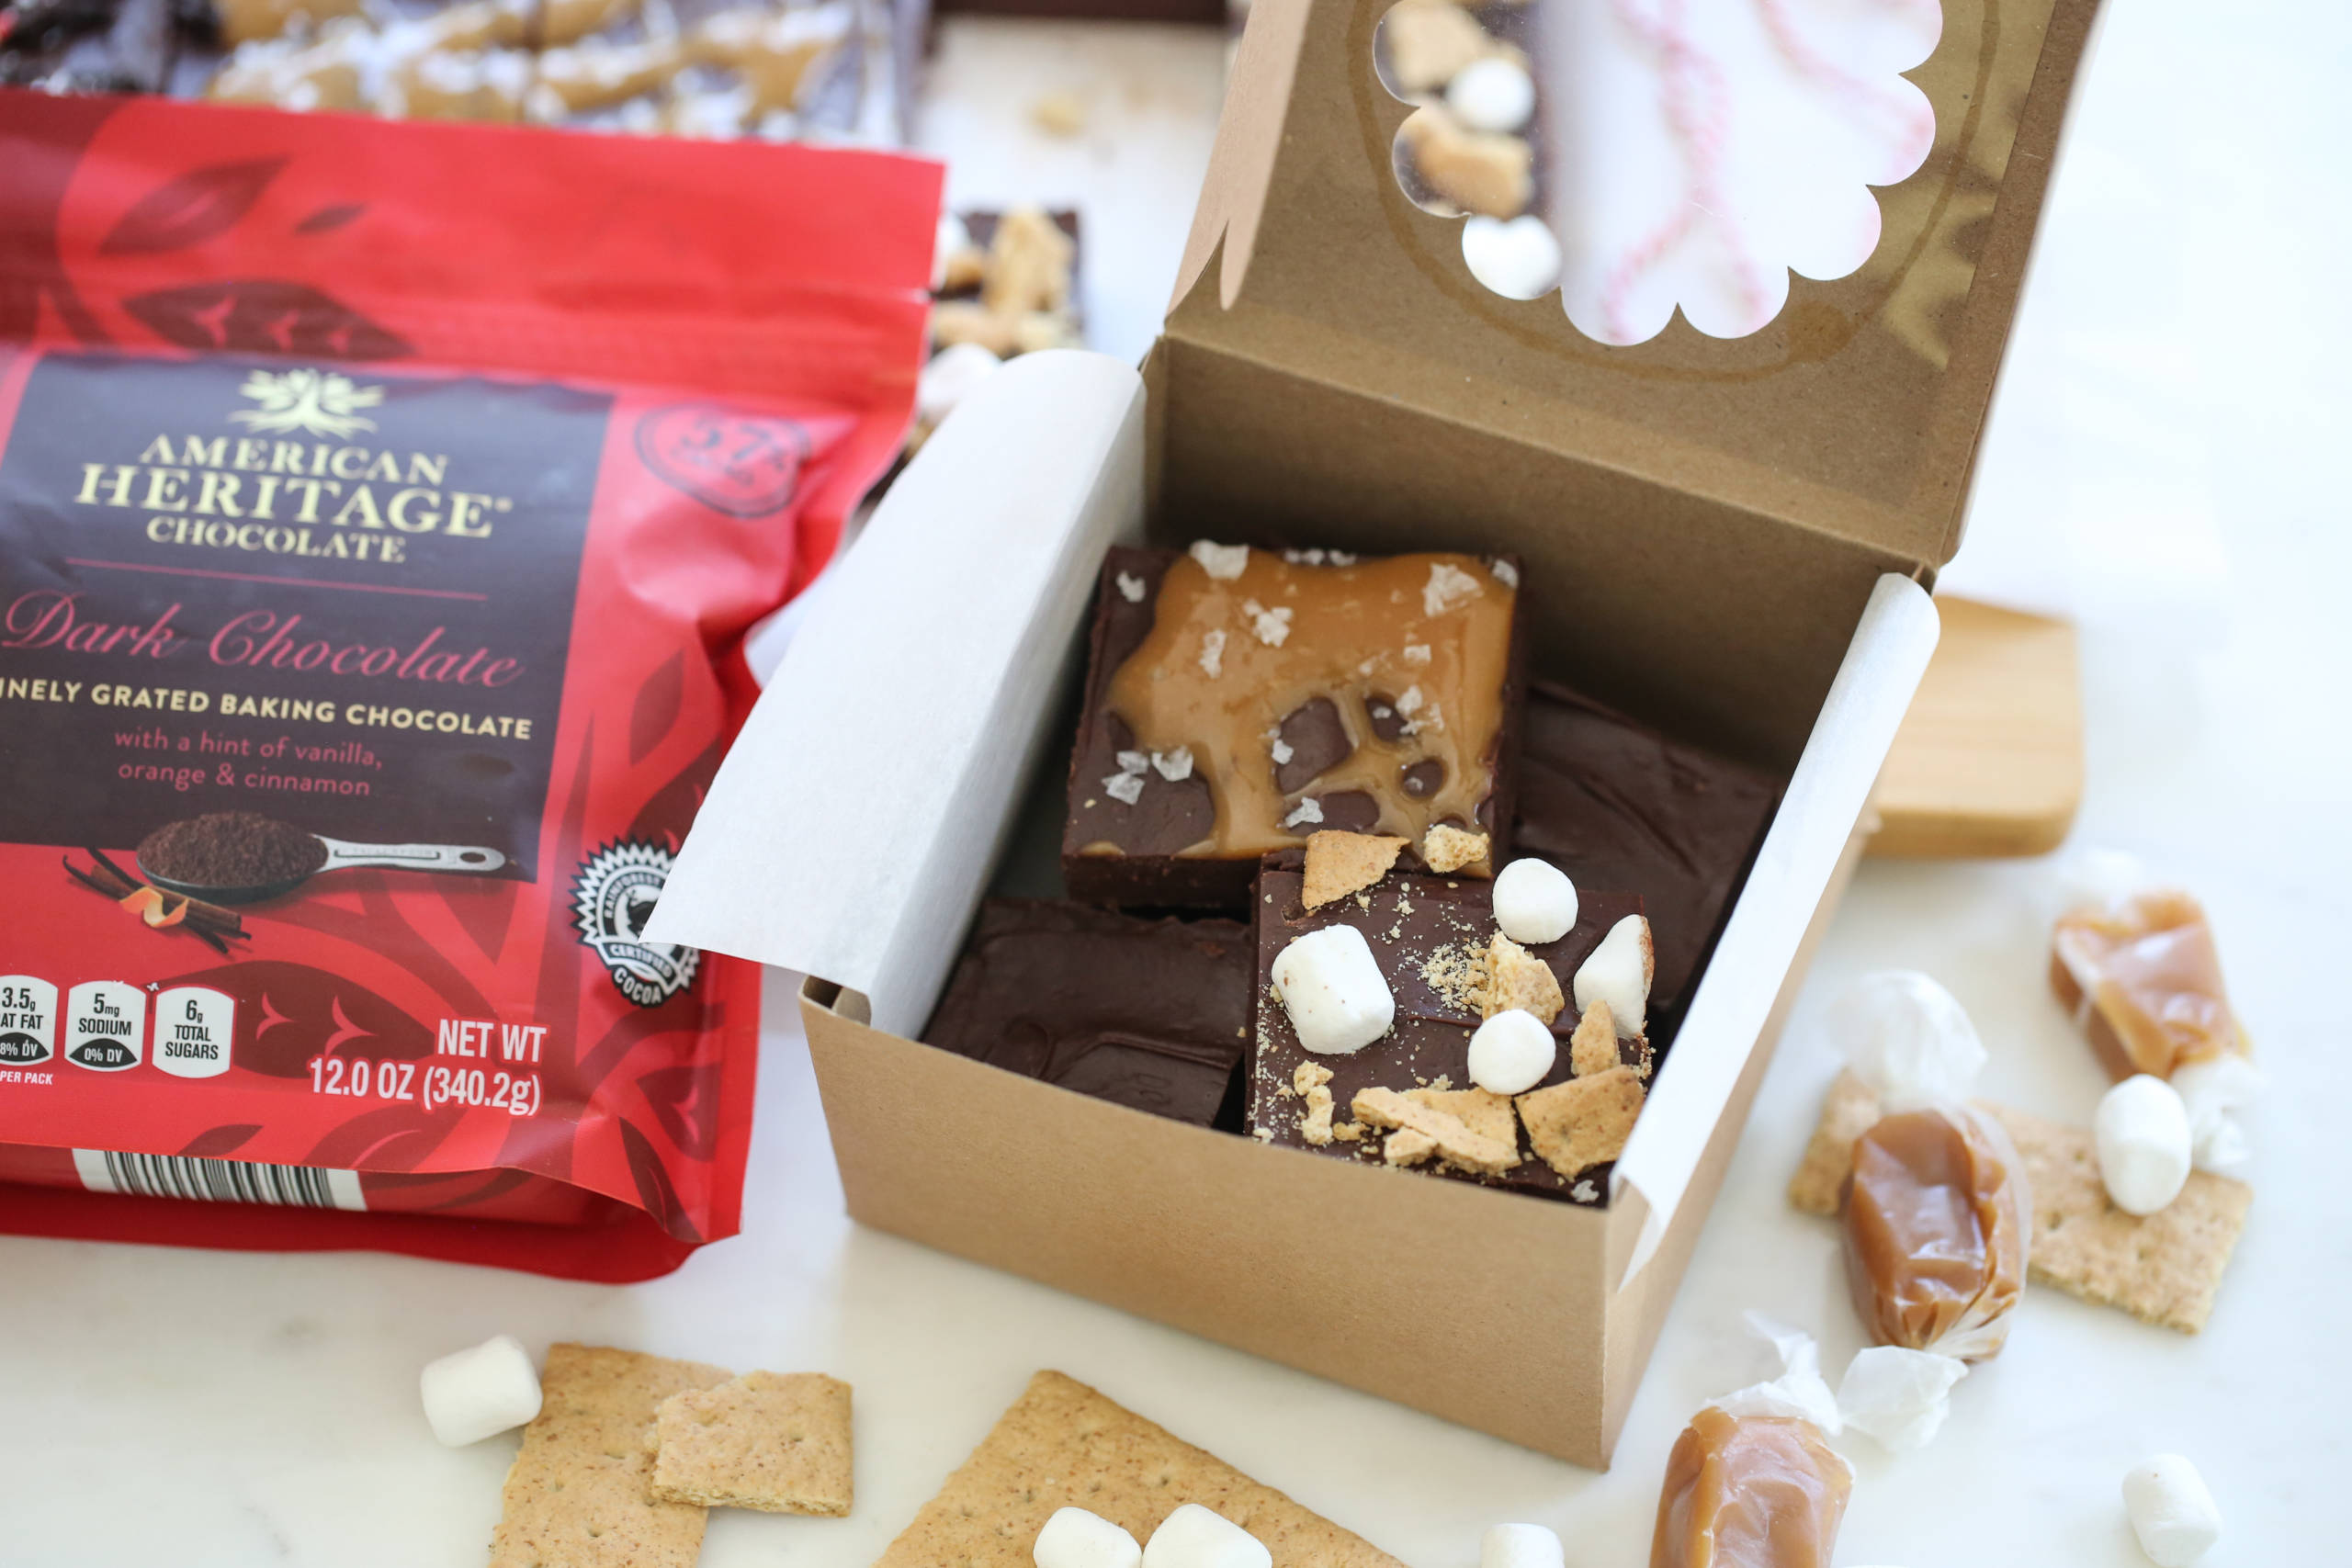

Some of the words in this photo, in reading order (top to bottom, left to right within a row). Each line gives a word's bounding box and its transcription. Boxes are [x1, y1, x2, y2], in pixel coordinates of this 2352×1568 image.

[140, 434, 449, 486] AMERICAN
[146, 516, 406, 563] CHOCOLATE
[2, 590, 186, 659] Dark
[209, 610, 526, 686] Chocolate
[91, 683, 209, 712] GRATED
[220, 694, 335, 723] BAKING
[345, 705, 533, 739] CHOCOLATE
[114, 727, 169, 750] with
[177, 736, 190, 751] a
[199, 731, 251, 756] hint
[259, 736, 290, 758] of
[295, 741, 383, 771] vanilla,
[119, 763, 206, 792] orange
[216, 762, 235, 786] &
[244, 766, 370, 795] cinnamon
[614, 967, 662, 1005] COCOA
[93, 993, 120, 1018] 5mg
[186, 999, 203, 1024] 6g
[20, 1013, 43, 1030] FAT
[78, 1017, 132, 1036] SODIUM
[174, 1024, 212, 1043] TOTAL
[21, 1043, 38, 1057] DV
[84, 1047, 104, 1062] 0%
[107, 1048, 123, 1064] DV
[164, 1041, 220, 1061] SUGARS
[437, 1019, 494, 1057] NET
[501, 1023, 548, 1063] WT
[0, 1069, 21, 1083] PER
[24, 1071, 53, 1086] PACK
[310, 1056, 369, 1098] 12.0
[377, 1062, 415, 1101] OZ
[423, 1066, 542, 1116] (340.2g)
